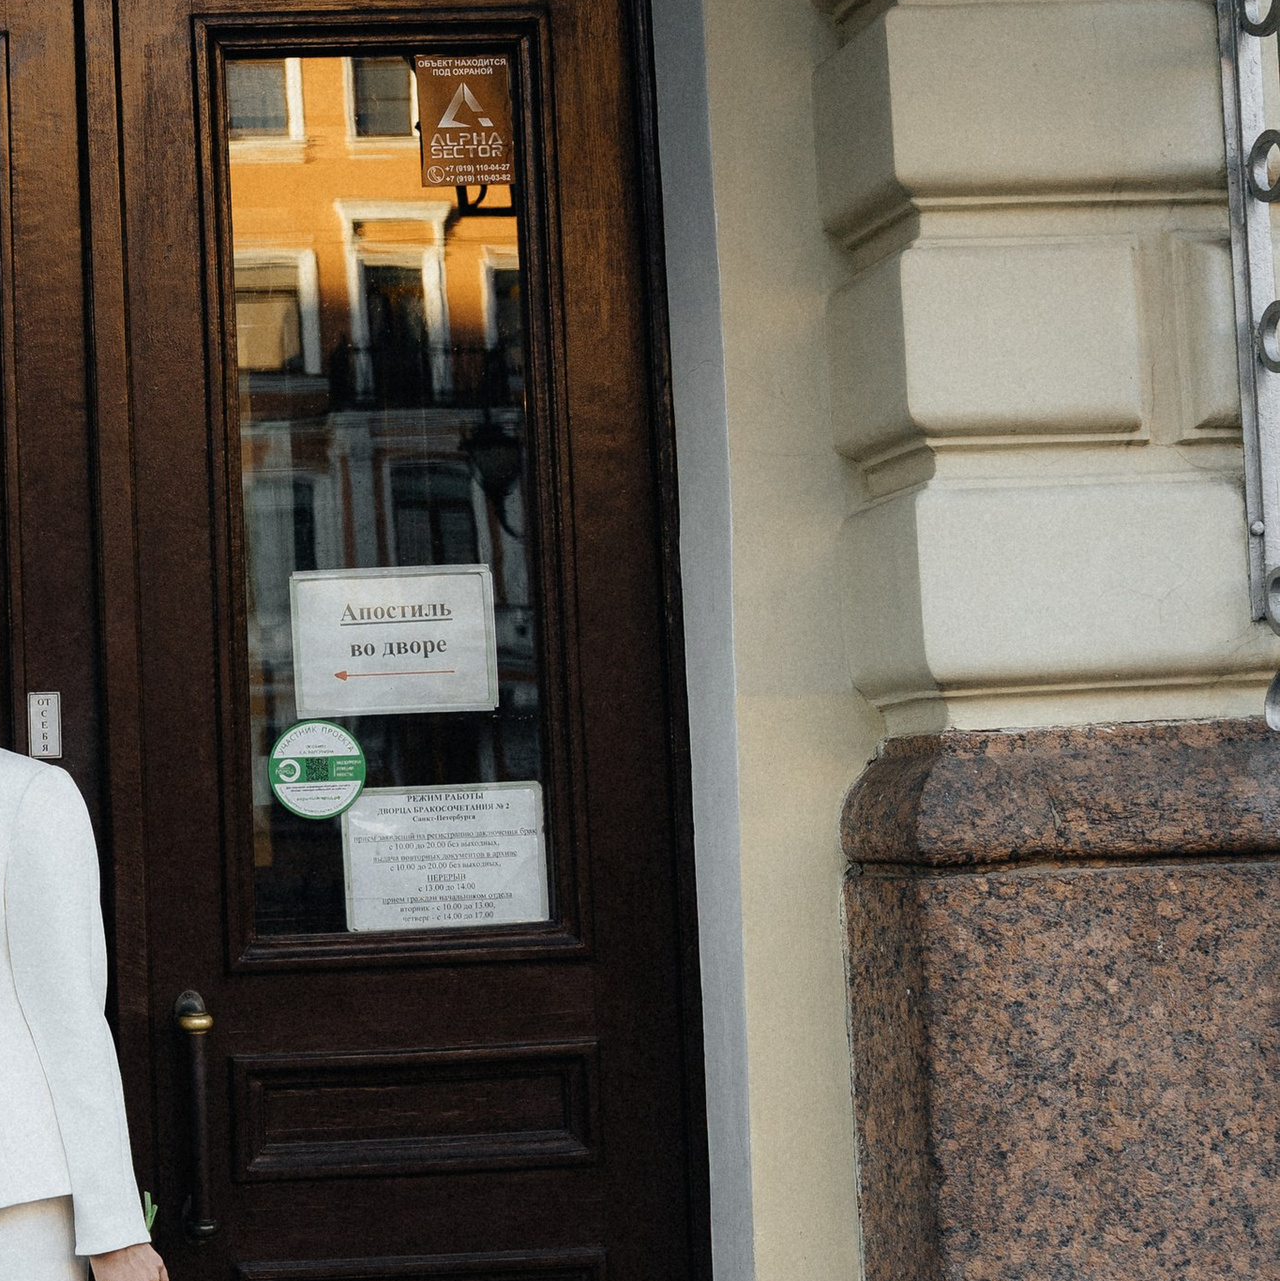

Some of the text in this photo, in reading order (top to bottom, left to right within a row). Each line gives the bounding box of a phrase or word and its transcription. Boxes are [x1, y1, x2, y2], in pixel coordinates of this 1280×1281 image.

[418, 58, 506, 68] ОБЪЕКТ НАХОДИТСЯ
[452, 67, 493, 76] ОХРАНОЙ
[430, 131, 503, 146] ALPHA
[431, 145, 503, 159] SECTOR
[341, 603, 452, 621] Апостиль
[350, 639, 447, 658] во дворе
[37, 698, 51, 706] ОТ
[41, 710, 49, 752] СЕБЯ
[278, 726, 354, 755] УЧАСТНИК ПРОЕКТА
[407, 794, 442, 802] РЕЖИМ
[377, 808, 411, 816] ДВОРЦА
[414, 803, 493, 813] БРАКОСОЧЕТАНИЯ
[412, 814, 476, 822] Санкт-Петербурга
[426, 832, 474, 840] регистрацию
[442, 852, 485, 860] документов
[396, 863, 415, 871] 10.00
[428, 862, 447, 870] 20.00
[427, 873, 466, 882] ПЕРЕРЫВ
[425, 884, 444, 892] 13.00
[382, 892, 512, 905] прием граждан начальником отдела
[443, 903, 462, 911] 10.00
[403, 915, 430, 923] четверг
[475, 911, 494, 919] 17.00
